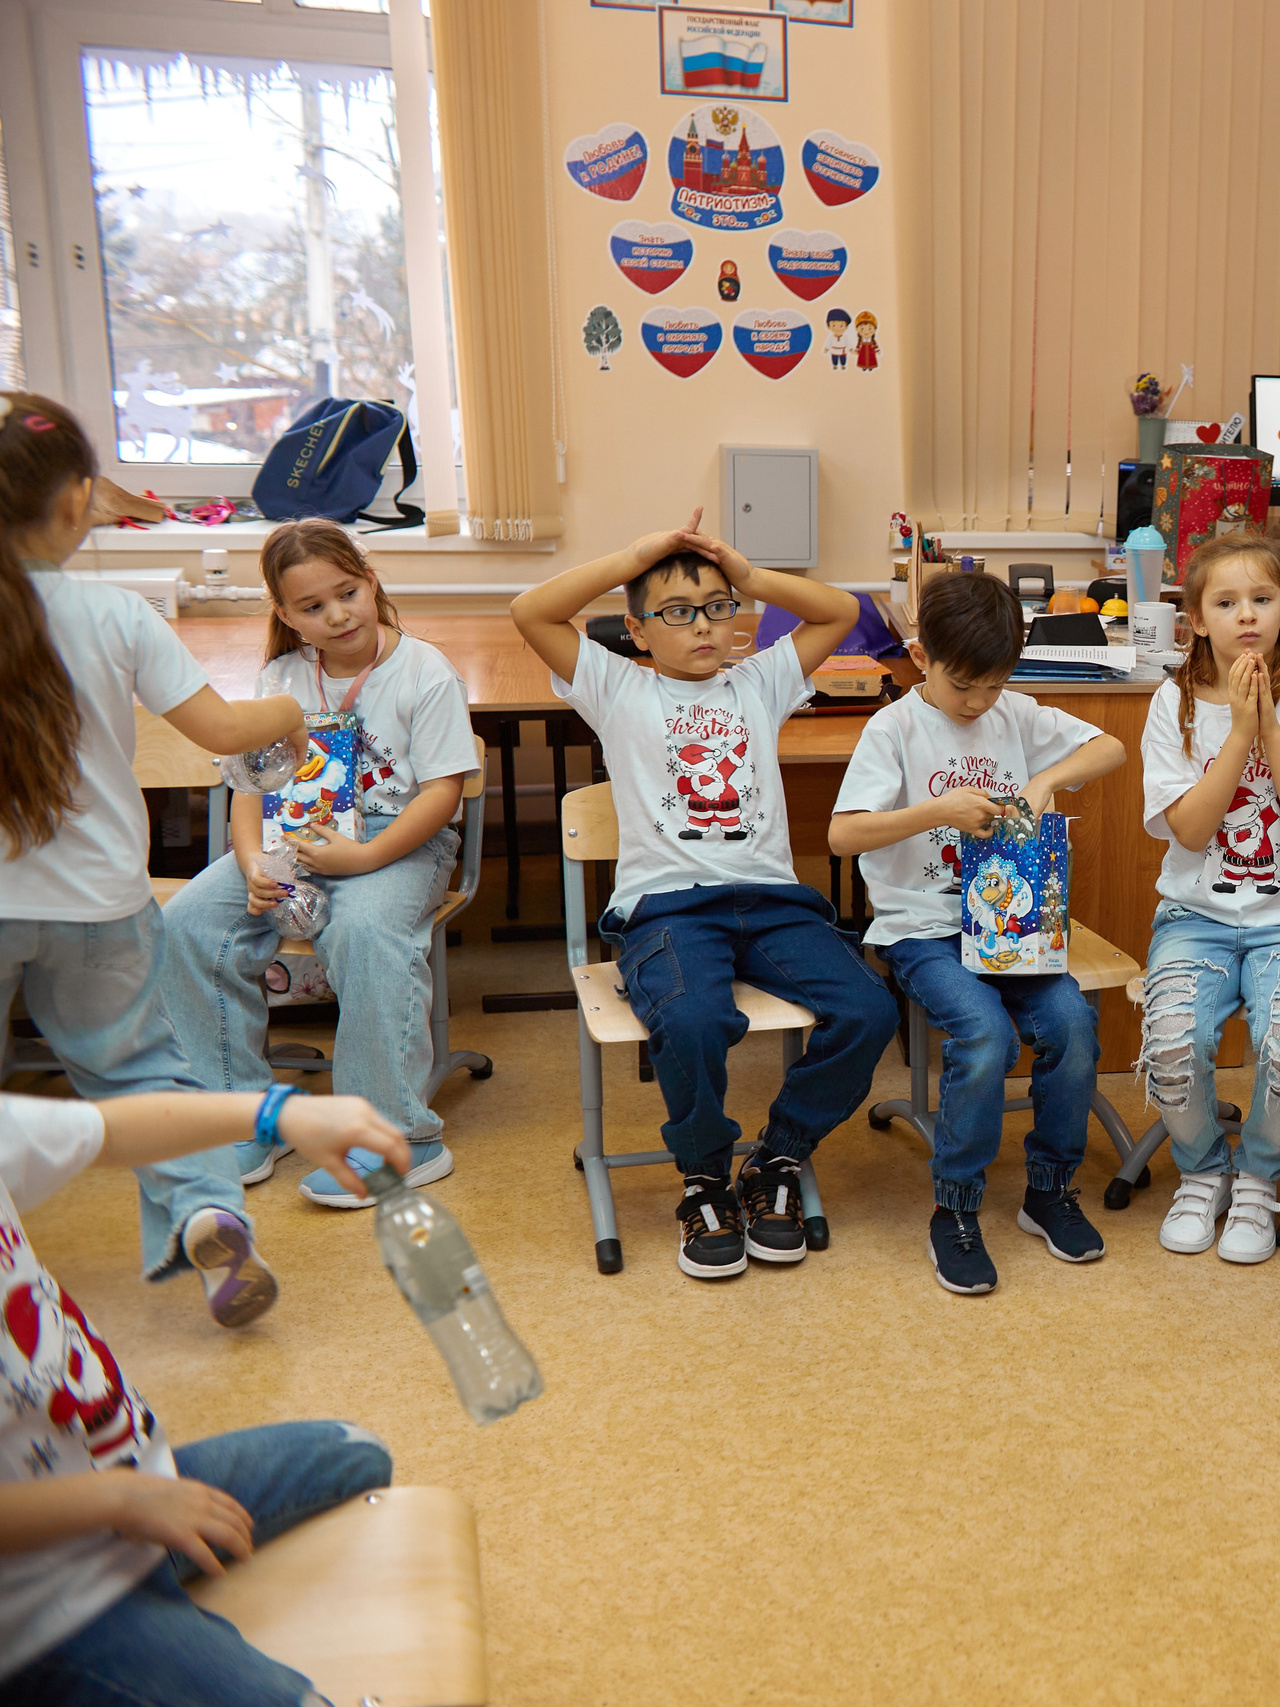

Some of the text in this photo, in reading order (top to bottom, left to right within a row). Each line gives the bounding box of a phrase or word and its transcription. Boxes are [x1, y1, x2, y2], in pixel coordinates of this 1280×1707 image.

[687, 15, 760, 27] ГОСУДАРСТВЕННЫЙ ФЛАГ
[687, 25, 761, 38] РОССИЙСКОЙ ФЕДЕРАЦИИ
[582, 139, 626, 164] Любовь
[818, 140, 867, 167] Готовность
[580, 144, 643, 182] к РОДИНЕ!
[816, 152, 863, 177] защищать
[812, 161, 863, 189] Отечество!
[678, 186, 776, 212] ПАТРИОТИЗМ-
[638, 234, 665, 245] Знать
[782, 248, 835, 260] Знать свою
[621, 256, 649, 268] своей
[777, 260, 840, 271] родословную!
[663, 320, 700, 331] Любить
[754, 319, 787, 328] Любовь
[657, 333, 708, 342] и охранять
[759, 331, 791, 341] своему
[662, 342, 704, 354] природу!
[754, 340, 790, 353] народу!
[1220, 416, 1242, 444] ИТЕЛЮ
[287, 418, 327, 488] SKECHE
[689, 704, 733, 724] Merry
[961, 755, 999, 775] Merry
[928, 769, 1020, 797] Christmas
